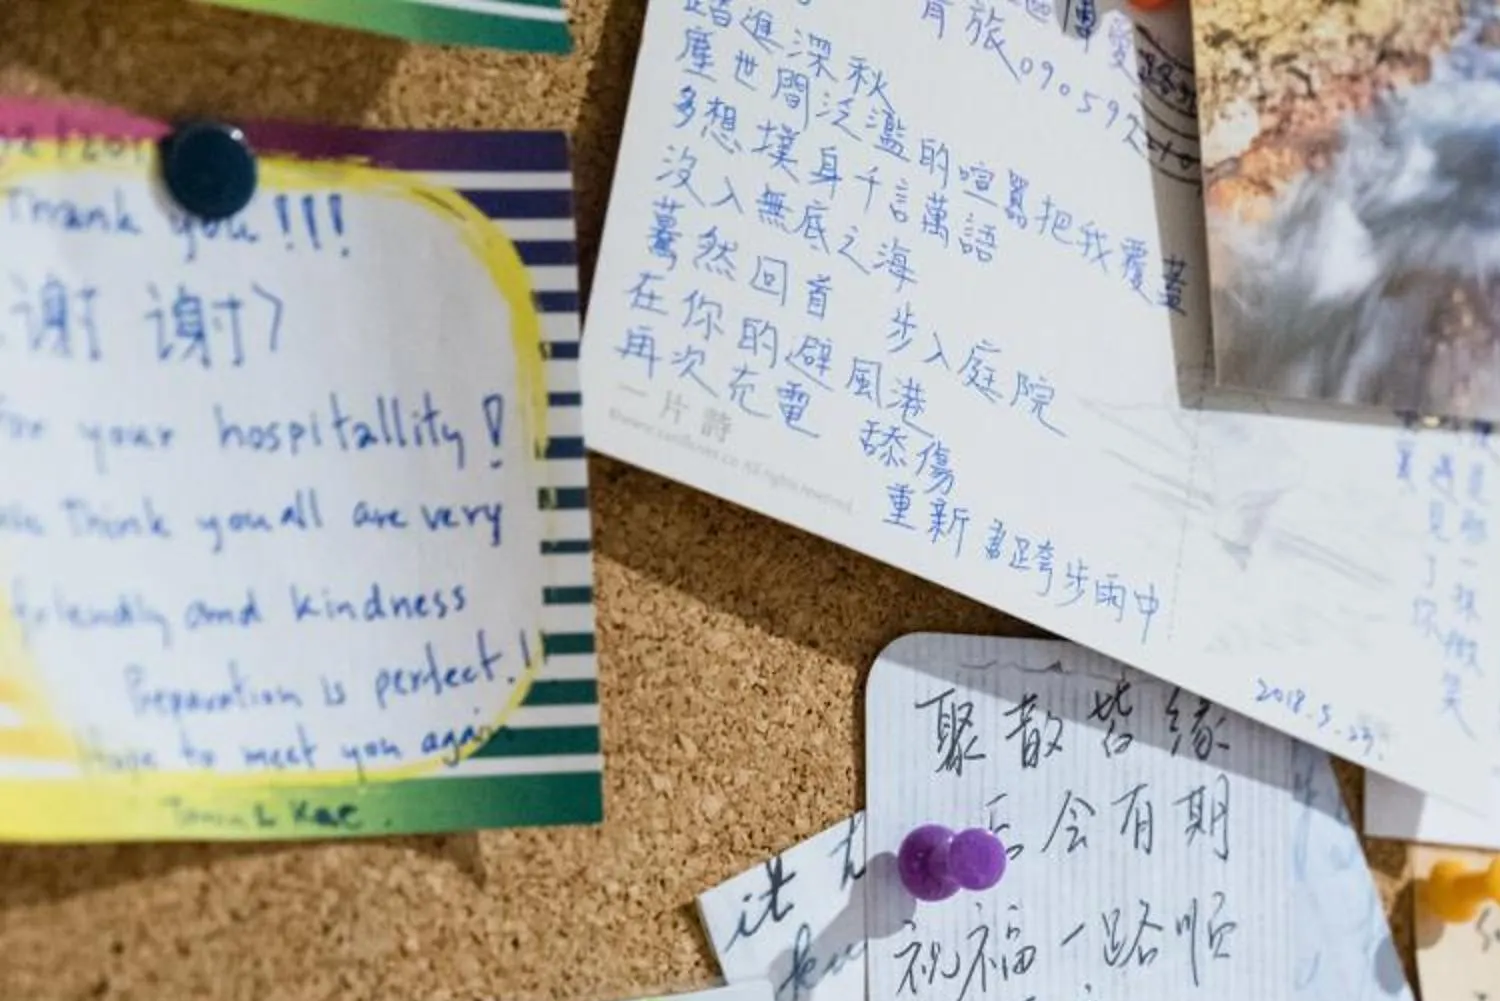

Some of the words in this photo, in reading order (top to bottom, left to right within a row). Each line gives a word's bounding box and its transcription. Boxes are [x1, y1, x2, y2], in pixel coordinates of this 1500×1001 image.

[353, 502, 408, 531] are
[425, 502, 504, 547] very
[291, 583, 466, 624] kindness
[321, 680, 347, 706] is
[244, 724, 317, 767] meet
[341, 742, 401, 783] you
